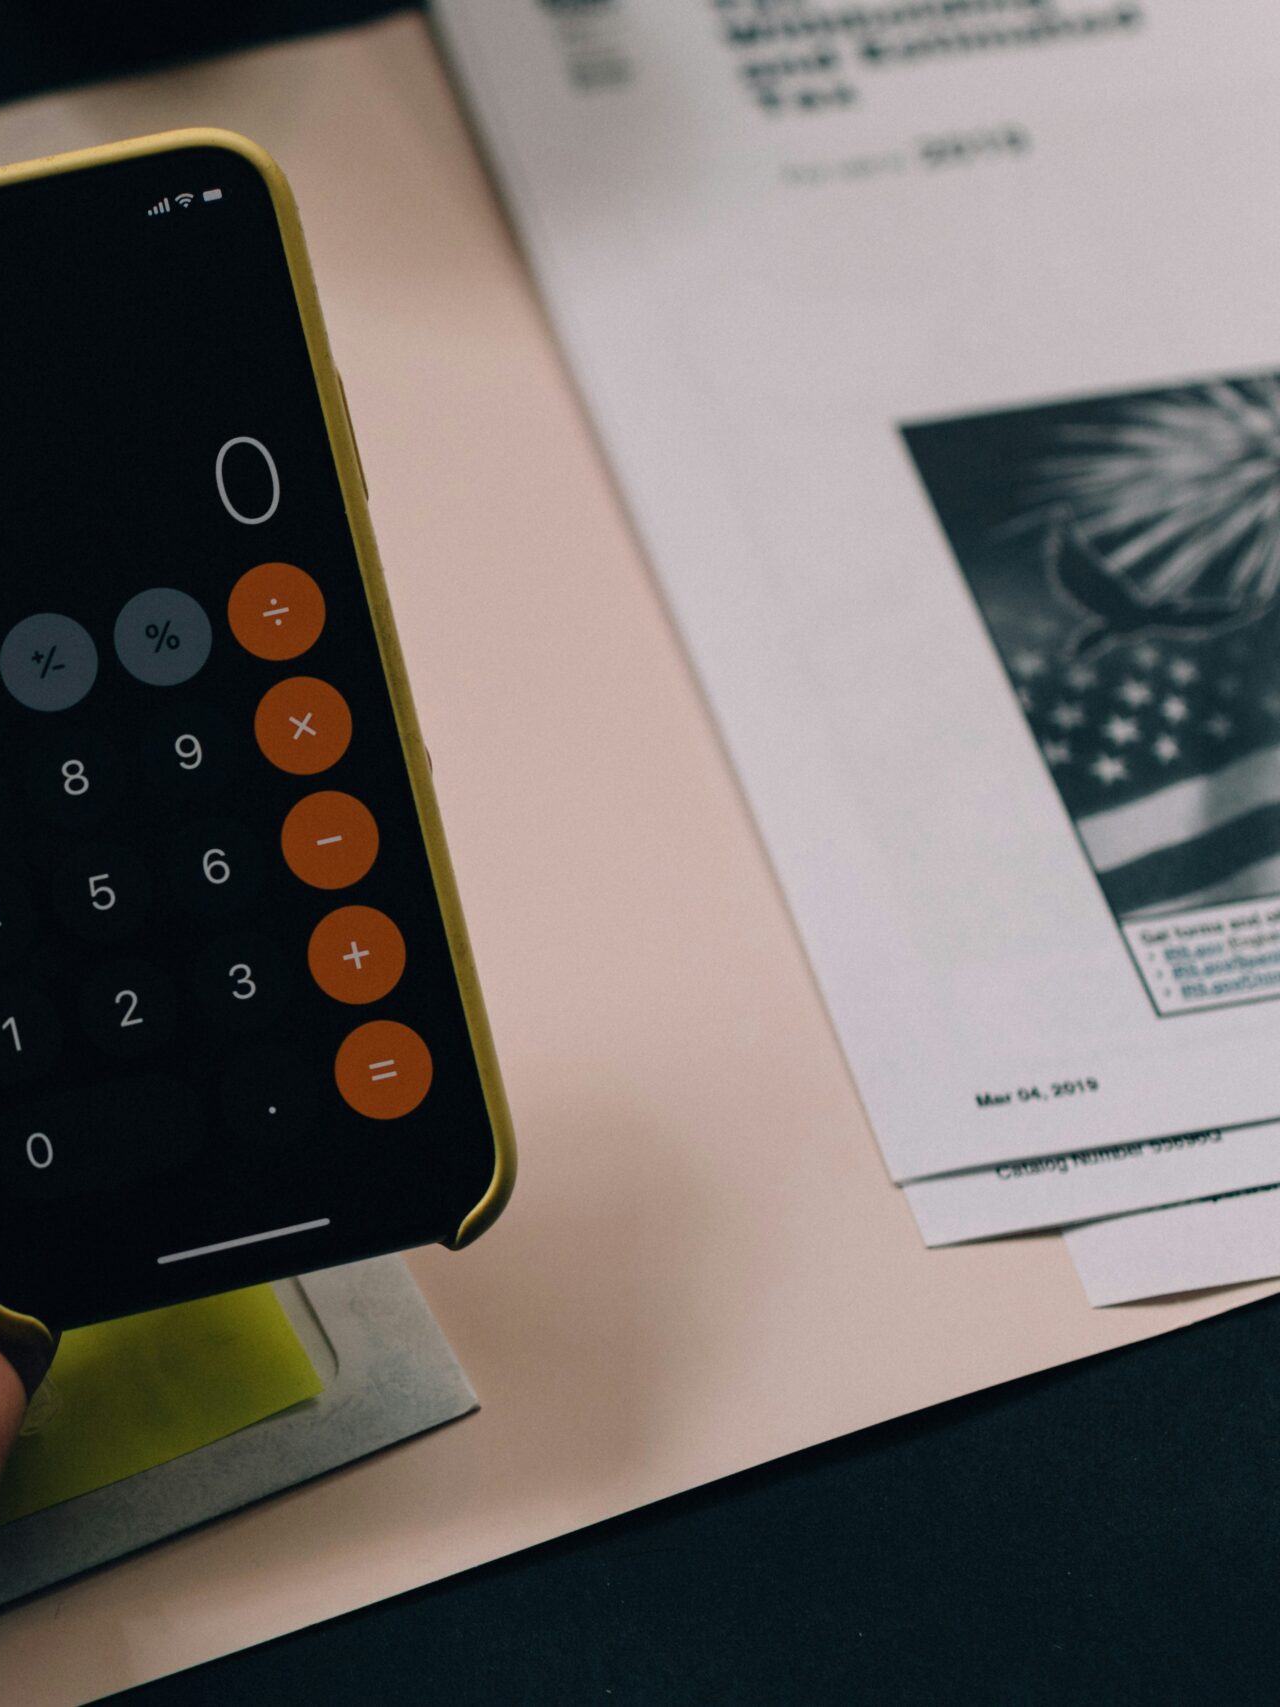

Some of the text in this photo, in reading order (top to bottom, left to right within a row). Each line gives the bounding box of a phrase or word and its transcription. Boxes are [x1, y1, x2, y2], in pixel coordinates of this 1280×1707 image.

[215, 436, 281, 525] 0
[144, 620, 181, 654] %
[61, 759, 90, 796] 8
[174, 733, 203, 770] 9
[88, 873, 116, 911] 5
[202, 848, 231, 885] 6
[1, 1016, 22, 1052] 1
[114, 989, 144, 1028] 2
[228, 963, 257, 1000] 3
[975, 1075, 1099, 1108] Mar 04, 2019
[26, 1132, 54, 1169] 0
